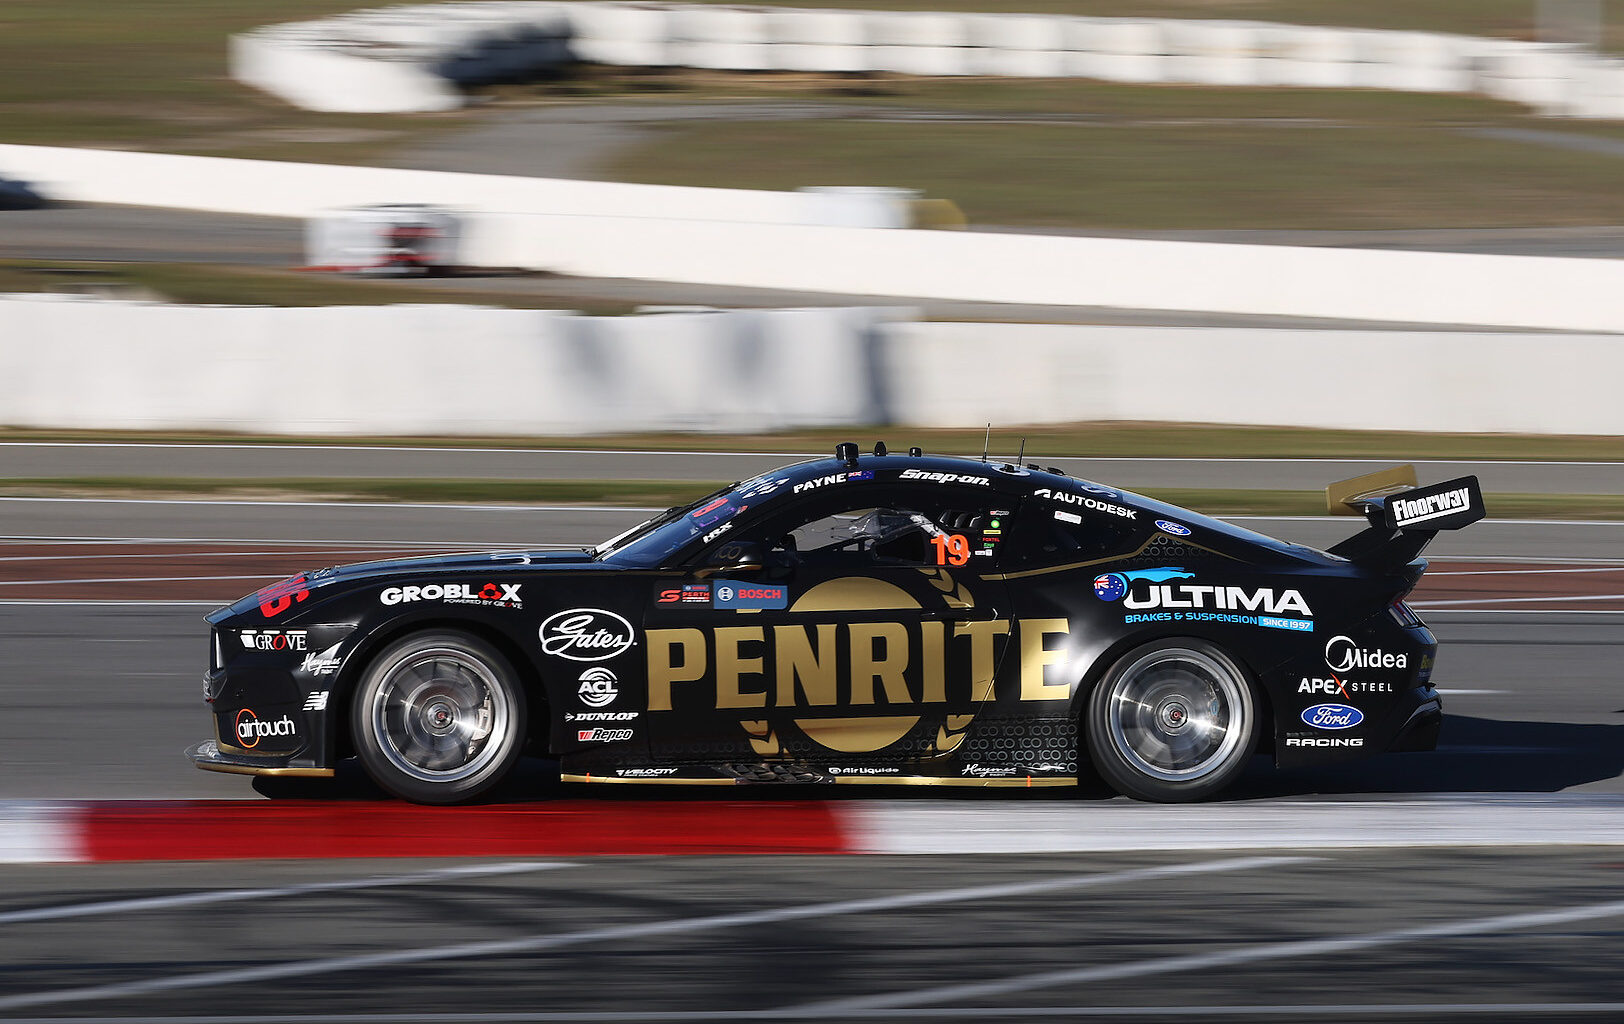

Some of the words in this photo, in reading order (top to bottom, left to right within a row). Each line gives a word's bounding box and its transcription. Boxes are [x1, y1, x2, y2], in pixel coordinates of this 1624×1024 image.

[793, 473, 847, 494] PAYNE
[1053, 491, 1137, 520] AUTODESK
[1391, 487, 1471, 521] Floorway
[930, 534, 969, 566] 19
[738, 589, 782, 599] BOSCH
[1123, 585, 1313, 616] ULTIMA
[1125, 612, 1172, 624] BRAKES
[1174, 612, 1184, 621] &
[1185, 612, 1258, 625] SUSPENSION
[1262, 618, 1289, 628] SINCE
[1290, 620, 1311, 630] 1997
[255, 634, 308, 651] GROVE
[542, 614, 628, 655] Gates
[644, 617, 1072, 712] PENRITE
[1336, 648, 1408, 669] Midea
[578, 681, 618, 694] ACL
[1297, 676, 1350, 697] APEX
[1352, 682, 1393, 692] STEEL
[238, 714, 296, 738] airtouch
[574, 712, 639, 721] DUNLOP
[1312, 706, 1352, 726] Ford
[591, 728, 634, 742] Repco
[1285, 738, 1364, 747] RACING
